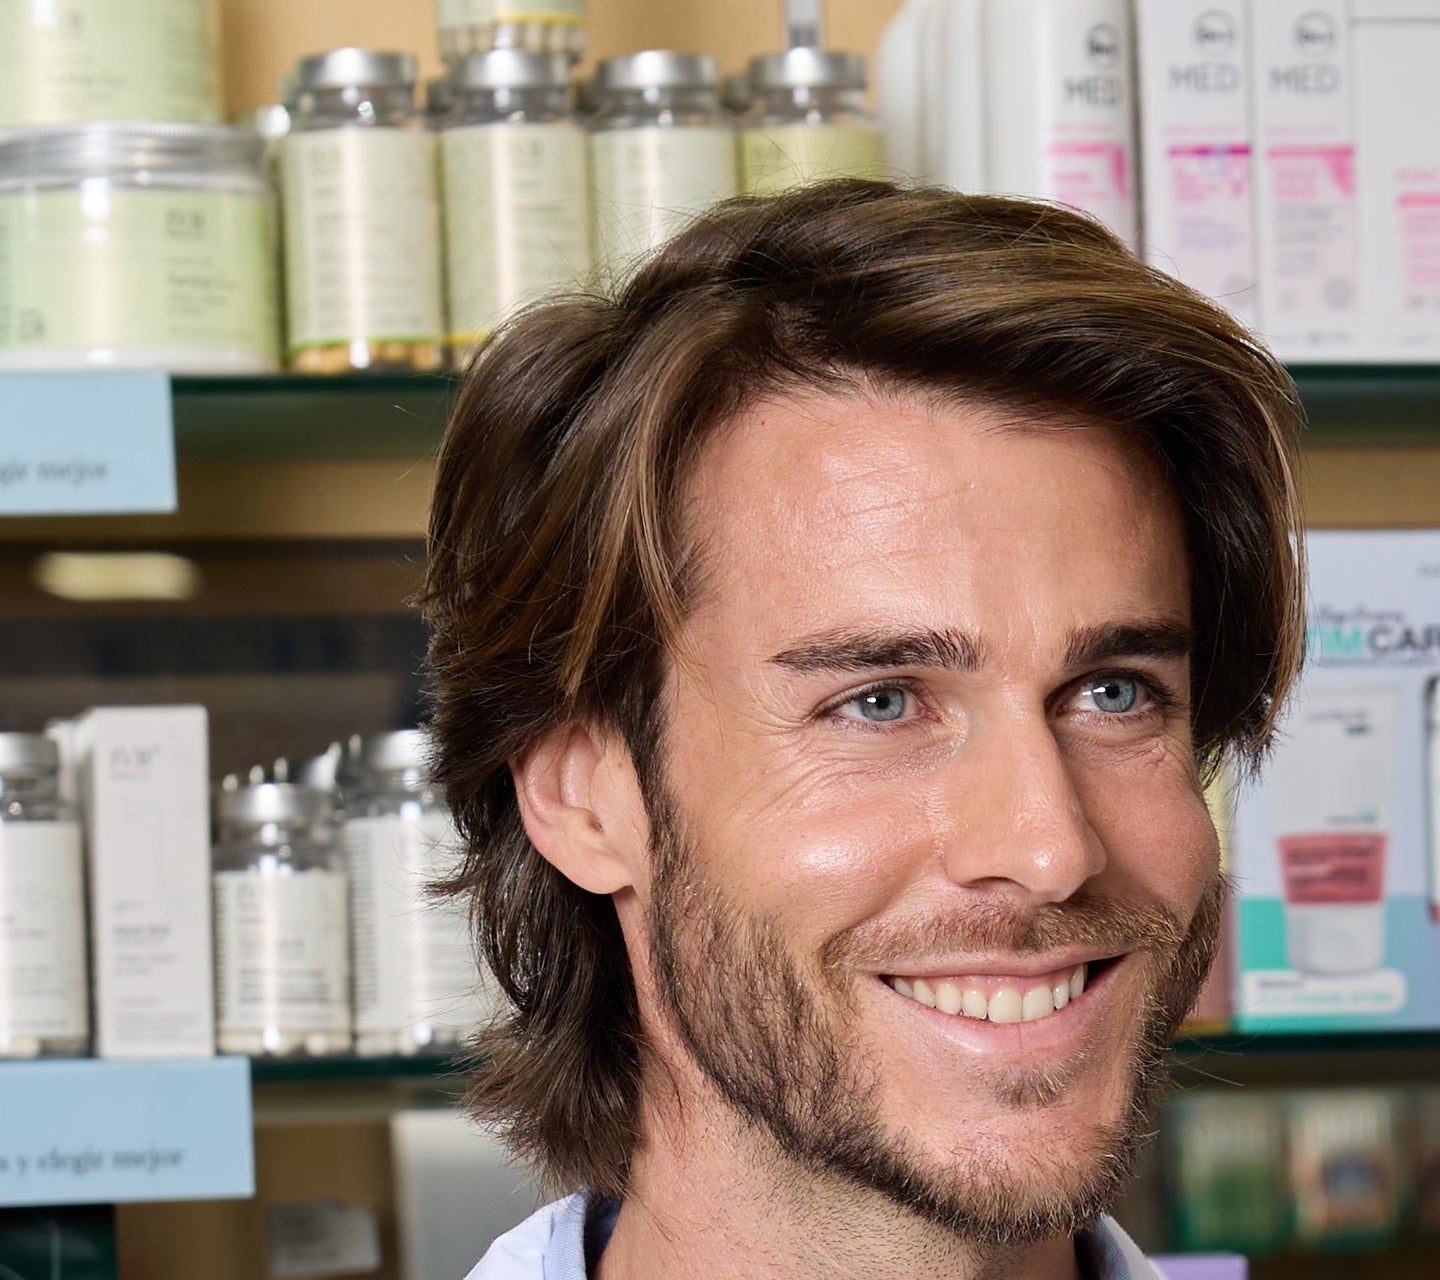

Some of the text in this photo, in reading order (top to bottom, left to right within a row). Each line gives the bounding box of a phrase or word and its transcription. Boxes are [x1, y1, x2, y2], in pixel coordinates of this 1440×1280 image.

[1168, 64, 1241, 96] MED
[1268, 64, 1343, 96] MED
[35, 456, 109, 488] mejor
[15, 1155, 33, 1182] y
[37, 1148, 106, 1178] elegir
[112, 1145, 184, 1175] mejor
